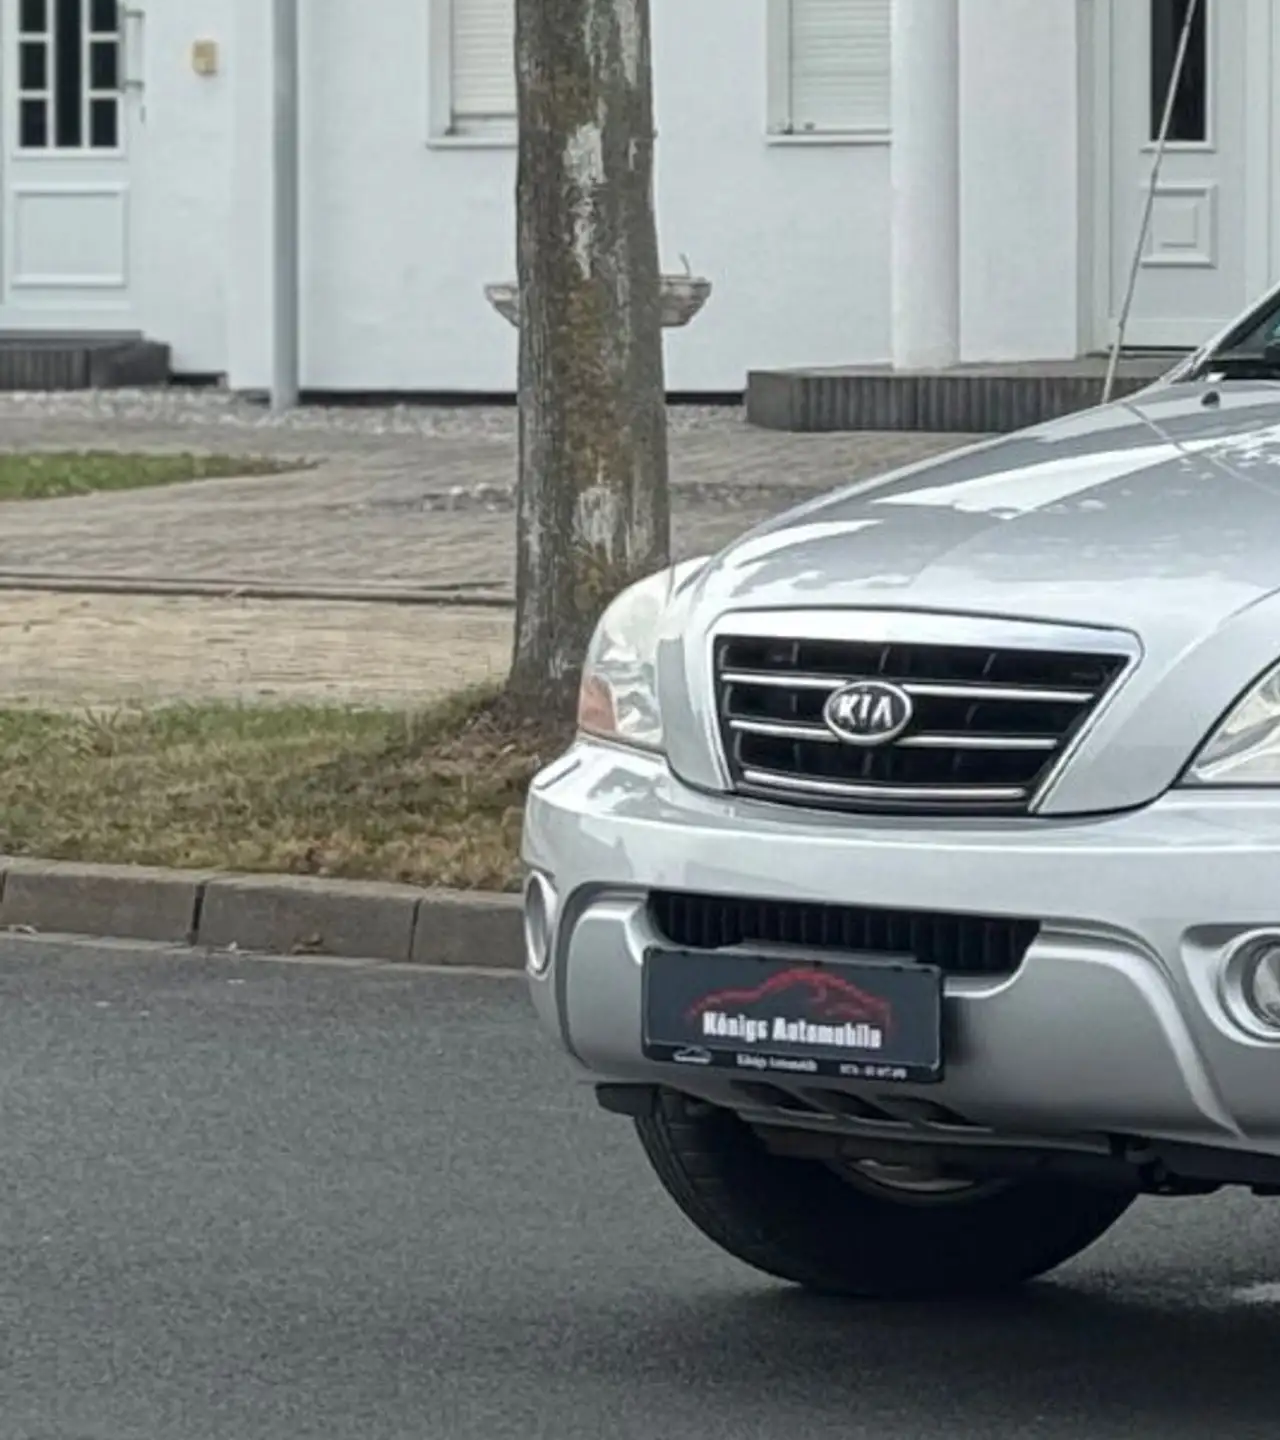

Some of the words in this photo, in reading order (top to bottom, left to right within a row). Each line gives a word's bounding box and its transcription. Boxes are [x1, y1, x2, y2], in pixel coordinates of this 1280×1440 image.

[837, 692, 894, 729] KIA
[703, 1011, 768, 1043] Königs
[772, 1016, 882, 1049] Automobile
